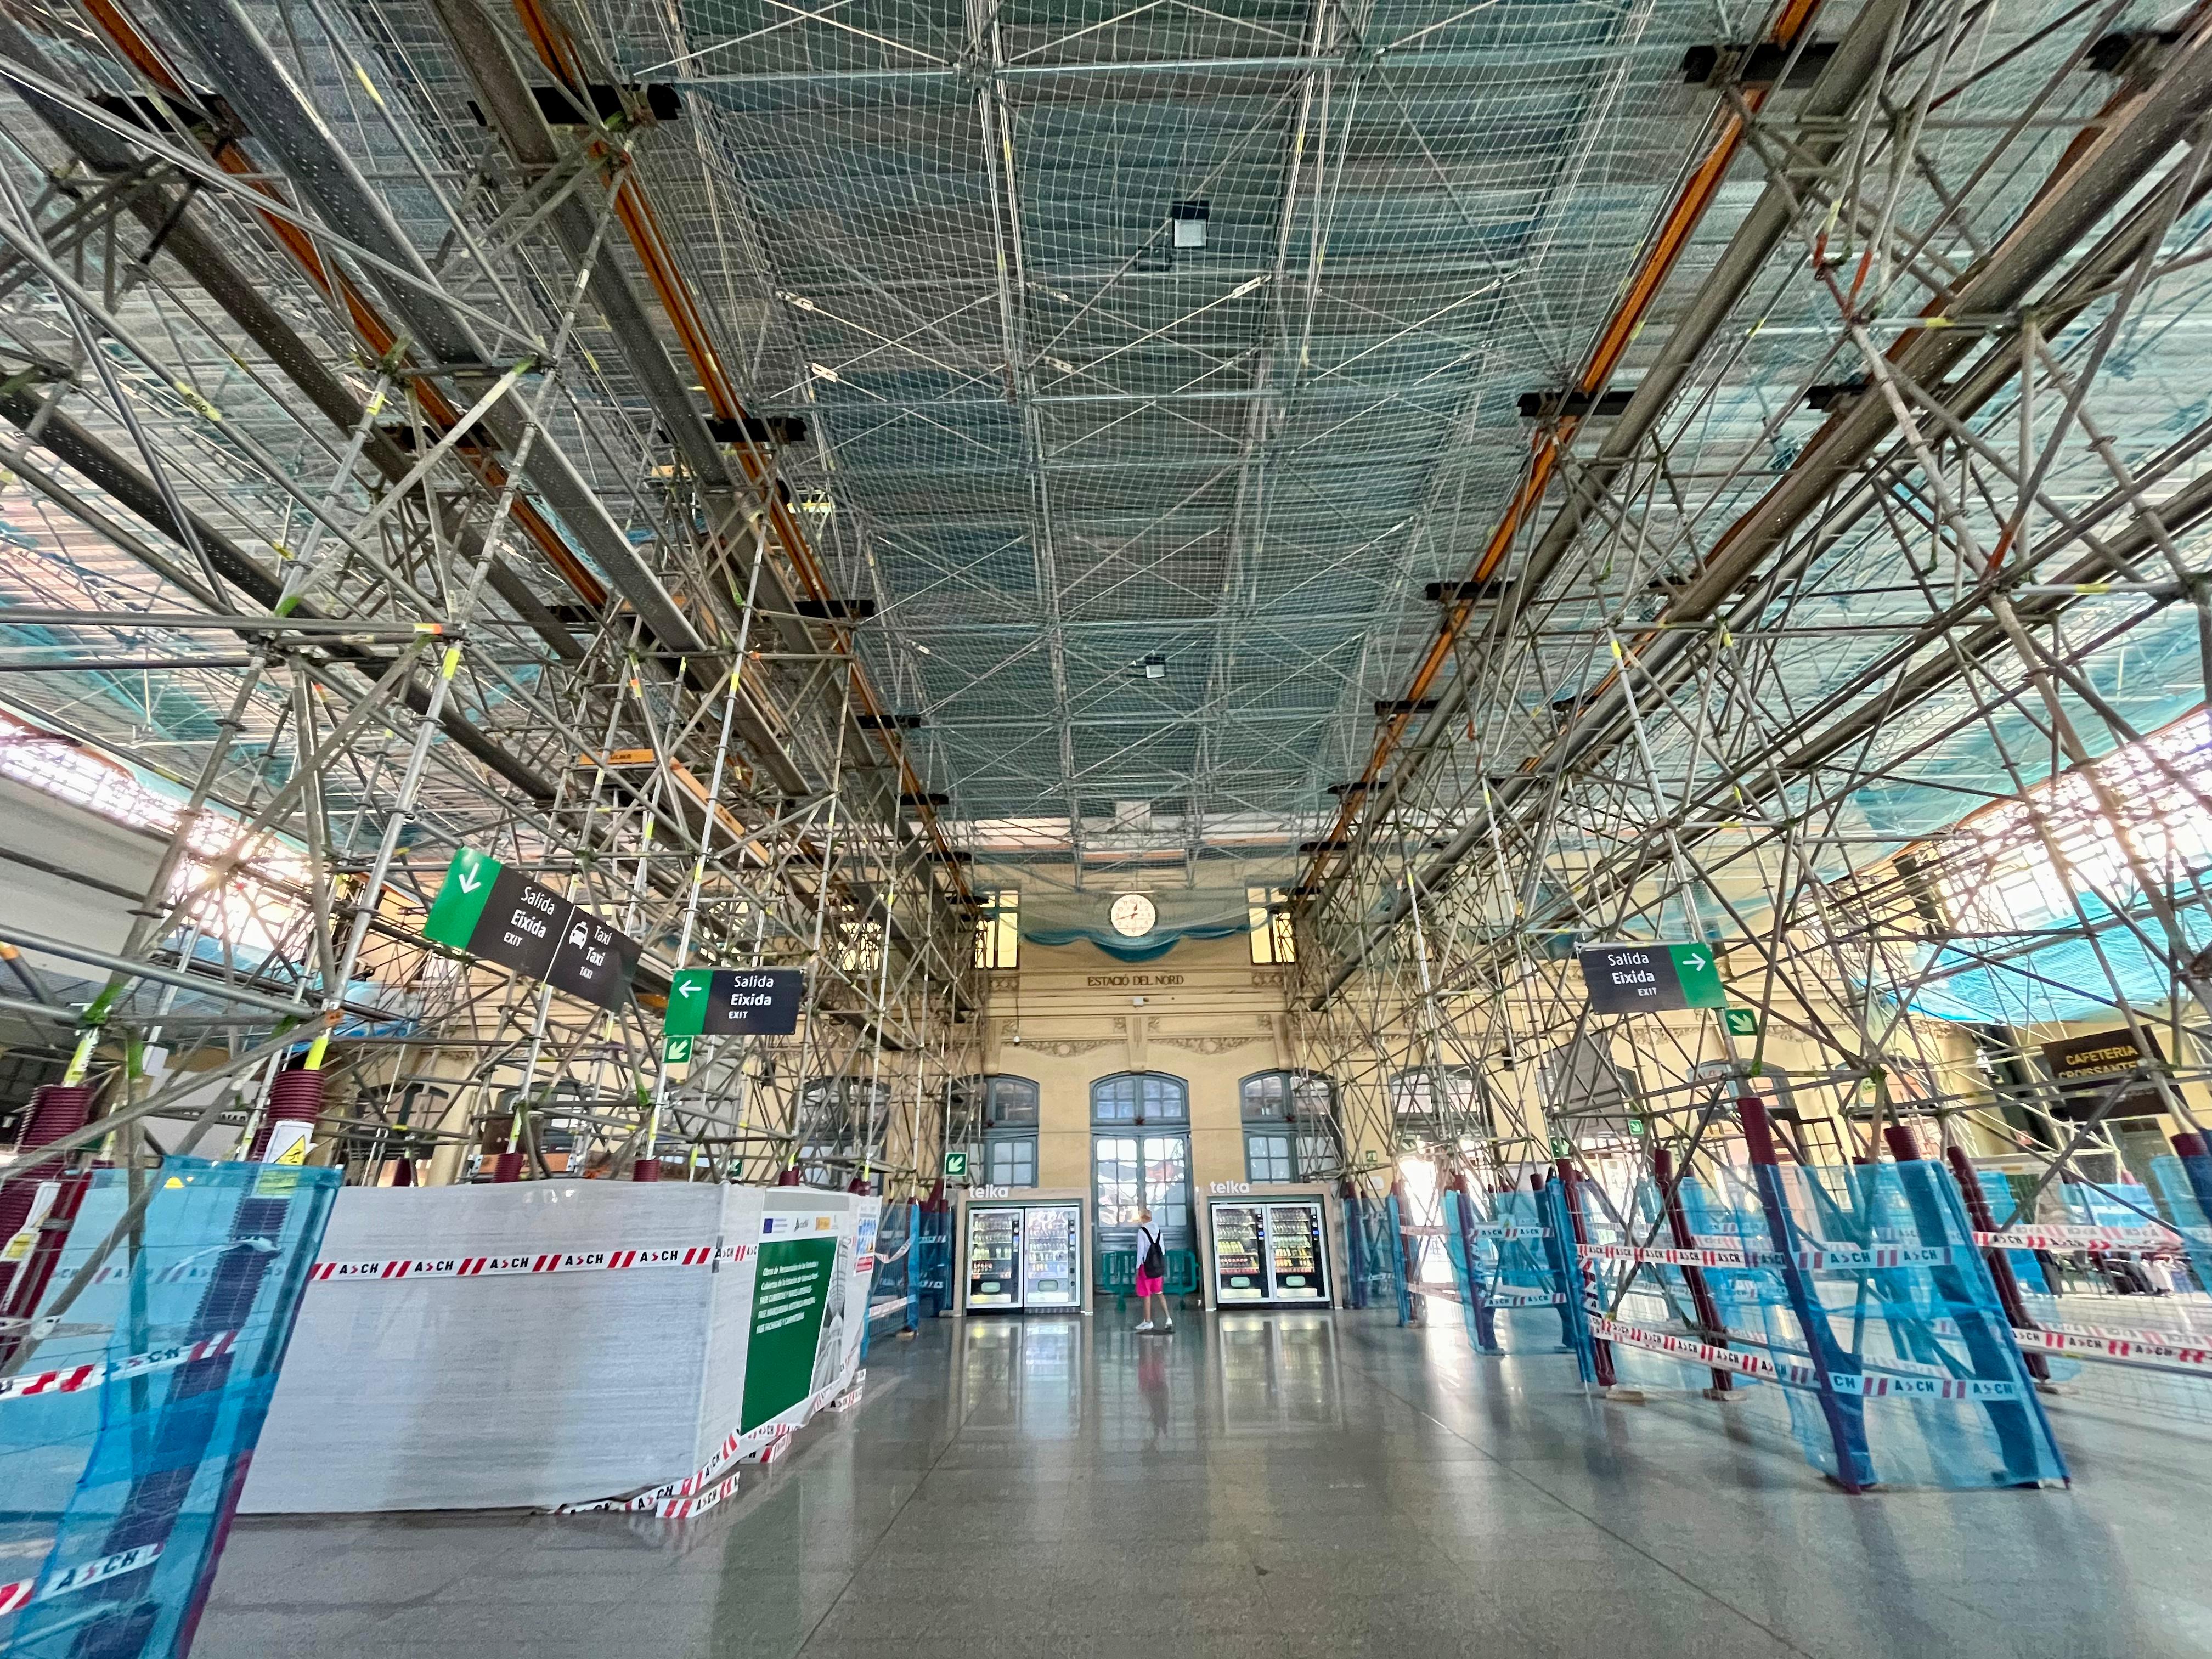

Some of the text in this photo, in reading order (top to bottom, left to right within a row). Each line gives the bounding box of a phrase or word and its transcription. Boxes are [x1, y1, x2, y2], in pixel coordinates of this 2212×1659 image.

[521, 886, 555, 915] Salida
[510, 909, 546, 938] Eixida
[503, 932, 523, 947] EXIT
[594, 926, 612, 945] Taxi
[586, 946, 606, 967] Taxi
[1607, 952, 1649, 966] Salida
[579, 966, 593, 980] TAXI
[1087, 974, 1184, 986] ESTACIÓ DEL NORD
[1612, 970, 1656, 984] Eixida
[734, 975, 774, 988] Salida
[1638, 987, 1657, 996] EXIT
[730, 993, 772, 1006] Eixida
[728, 1011, 748, 1019] EXIT
[2065, 1045, 2139, 1065] CAFETERIA
[2058, 1060, 2137, 1079] CROISSANTE
[1210, 1180, 1249, 1194] telka
[339, 1263, 379, 1274] ASCH
[414, 1260, 454, 1272] ASCH
[490, 1257, 529, 1269] ASCH
[565, 1254, 603, 1266] ASCH
[640, 1250, 678, 1262] ASCH
[714, 1248, 733, 1259] ASCH
[1680, 1251, 1700, 1261] ASCH
[1717, 1252, 1740, 1263] ASCH
[1830, 1249, 1938, 1263] ASCH ASCH
[2069, 1337, 2102, 1349] ASCH
[1678, 1341, 1697, 1353] ASCH
[1717, 1351, 1739, 1363] ASCH
[1895, 1379, 1934, 1392] ASCH
[1973, 1383, 2013, 1395] ASCH
[638, 1485, 673, 1510] ASCH
[55, 1550, 139, 1590] ASCH
